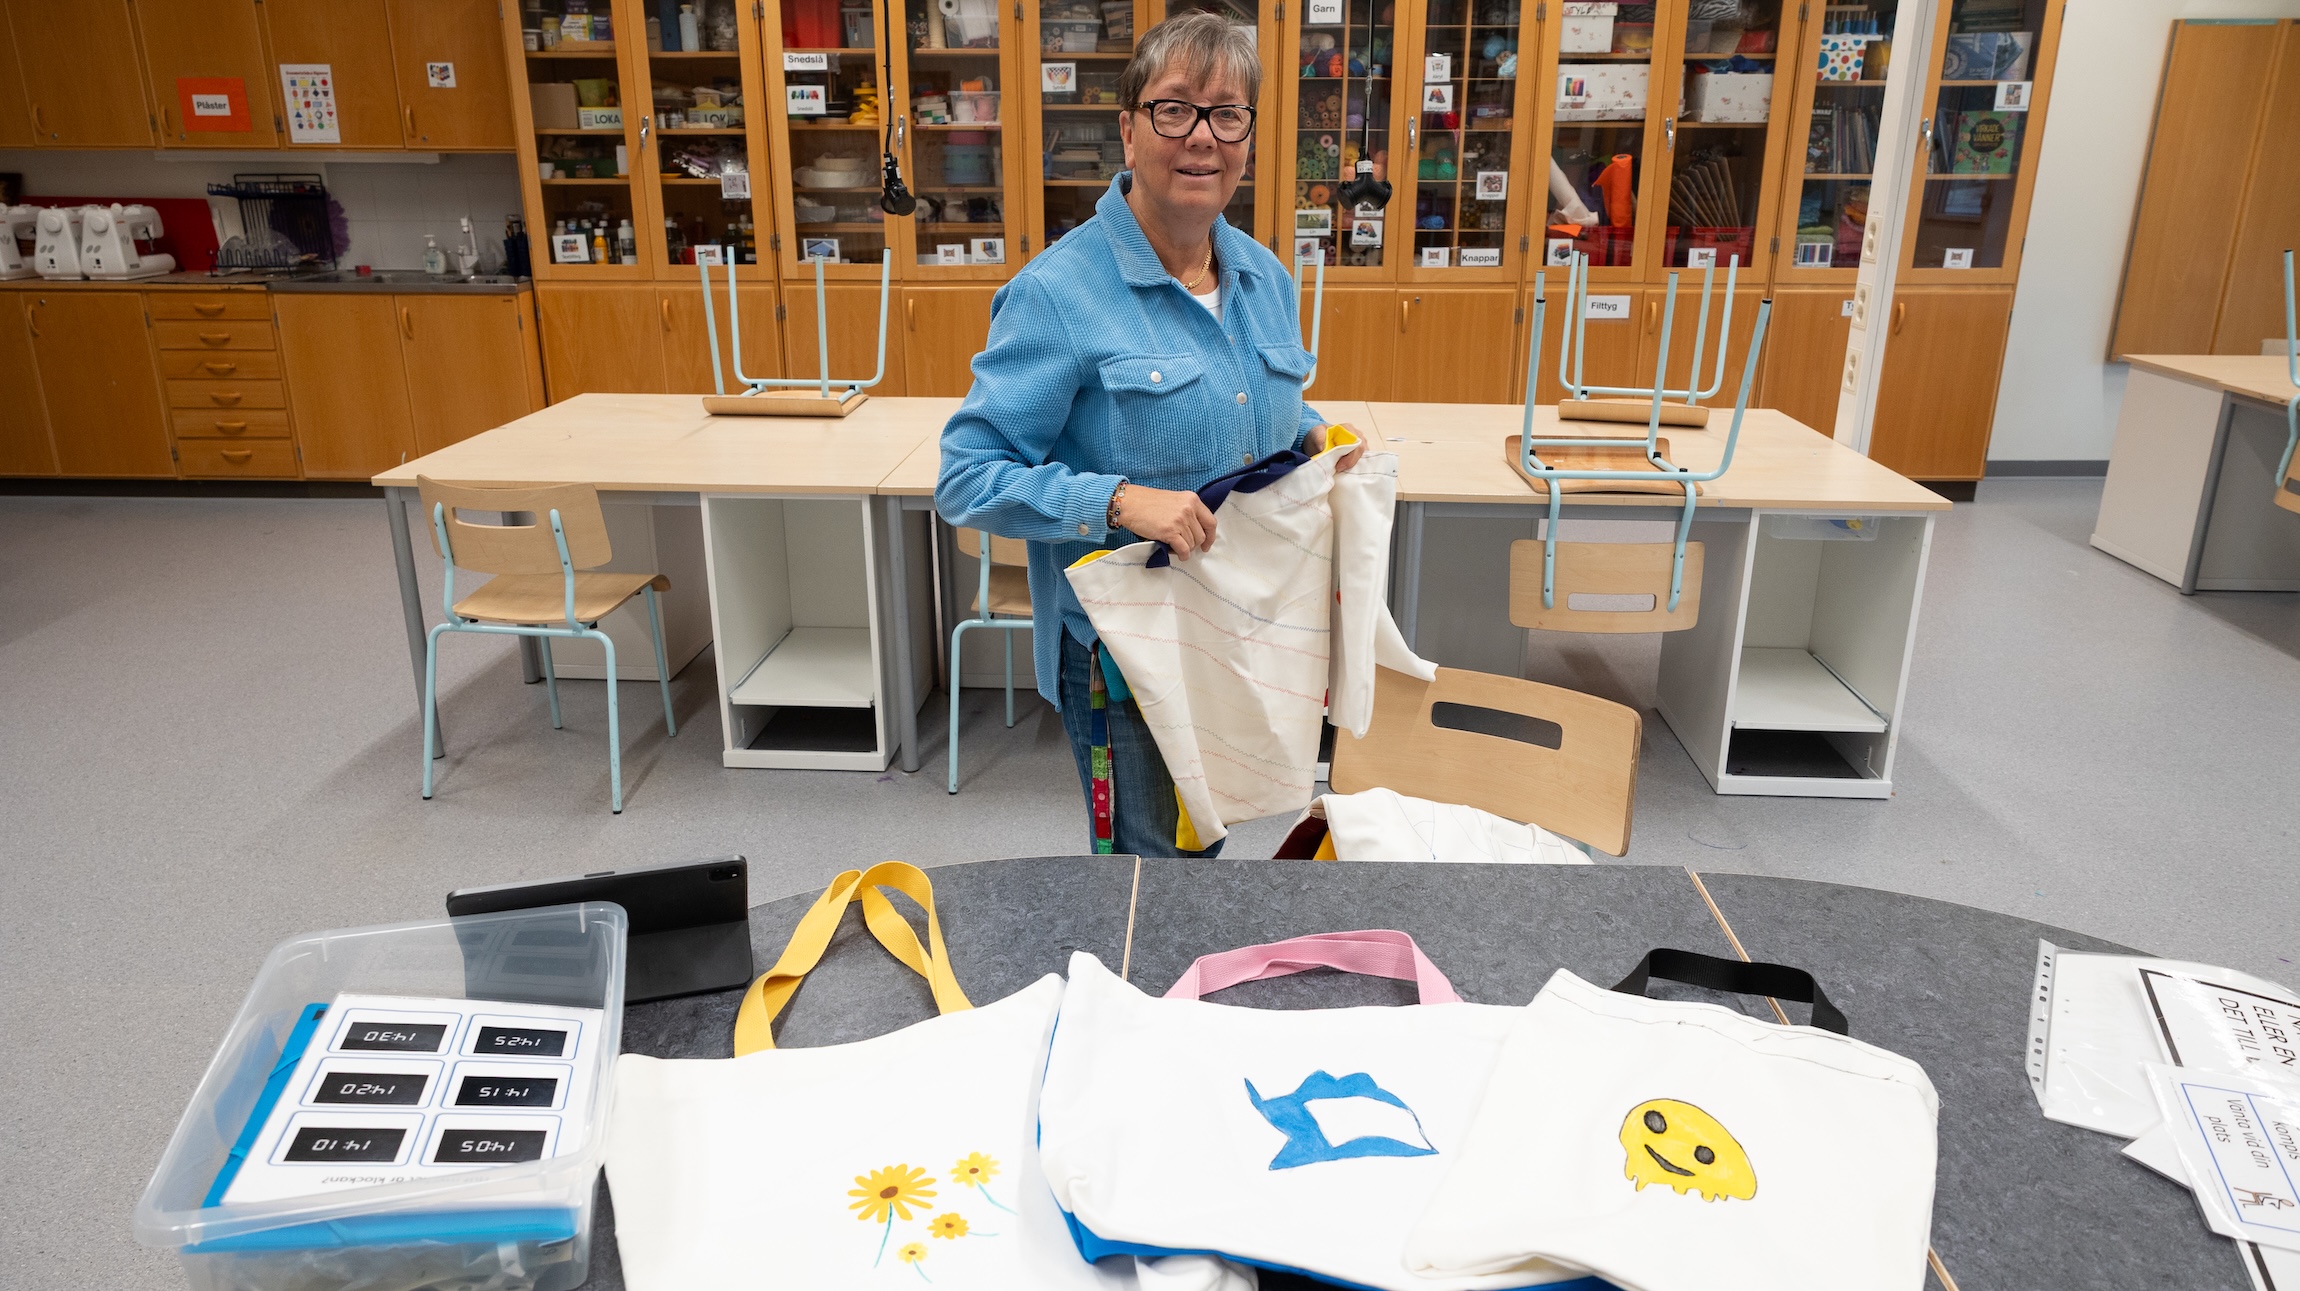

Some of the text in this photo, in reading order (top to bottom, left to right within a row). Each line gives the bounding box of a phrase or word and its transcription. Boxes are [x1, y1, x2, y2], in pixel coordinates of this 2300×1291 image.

[1313, 4, 1335, 13] Garn
[788, 54, 824, 64] Snedslå
[196, 101, 227, 110] Plåster
[594, 114, 621, 124] LOKA
[1461, 255, 1498, 263] Knappar
[1591, 302, 1618, 311] Filttyg
[2218, 997, 2248, 1025] DET
[363, 1031, 417, 1042] 14:30
[2231, 1029, 2261, 1051] TILL
[2252, 1005, 2288, 1043] ELLER
[2272, 1046, 2297, 1066] EN
[494, 1036, 541, 1047] 14:25
[340, 1082, 396, 1095] 14:20
[2203, 1115, 2231, 1143] plats
[2227, 1100, 2271, 1169] Vänta vid din
[2272, 1120, 2300, 1160] kompis
[460, 1140, 515, 1152] 14:05
[321, 1176, 386, 1184] klockan?
